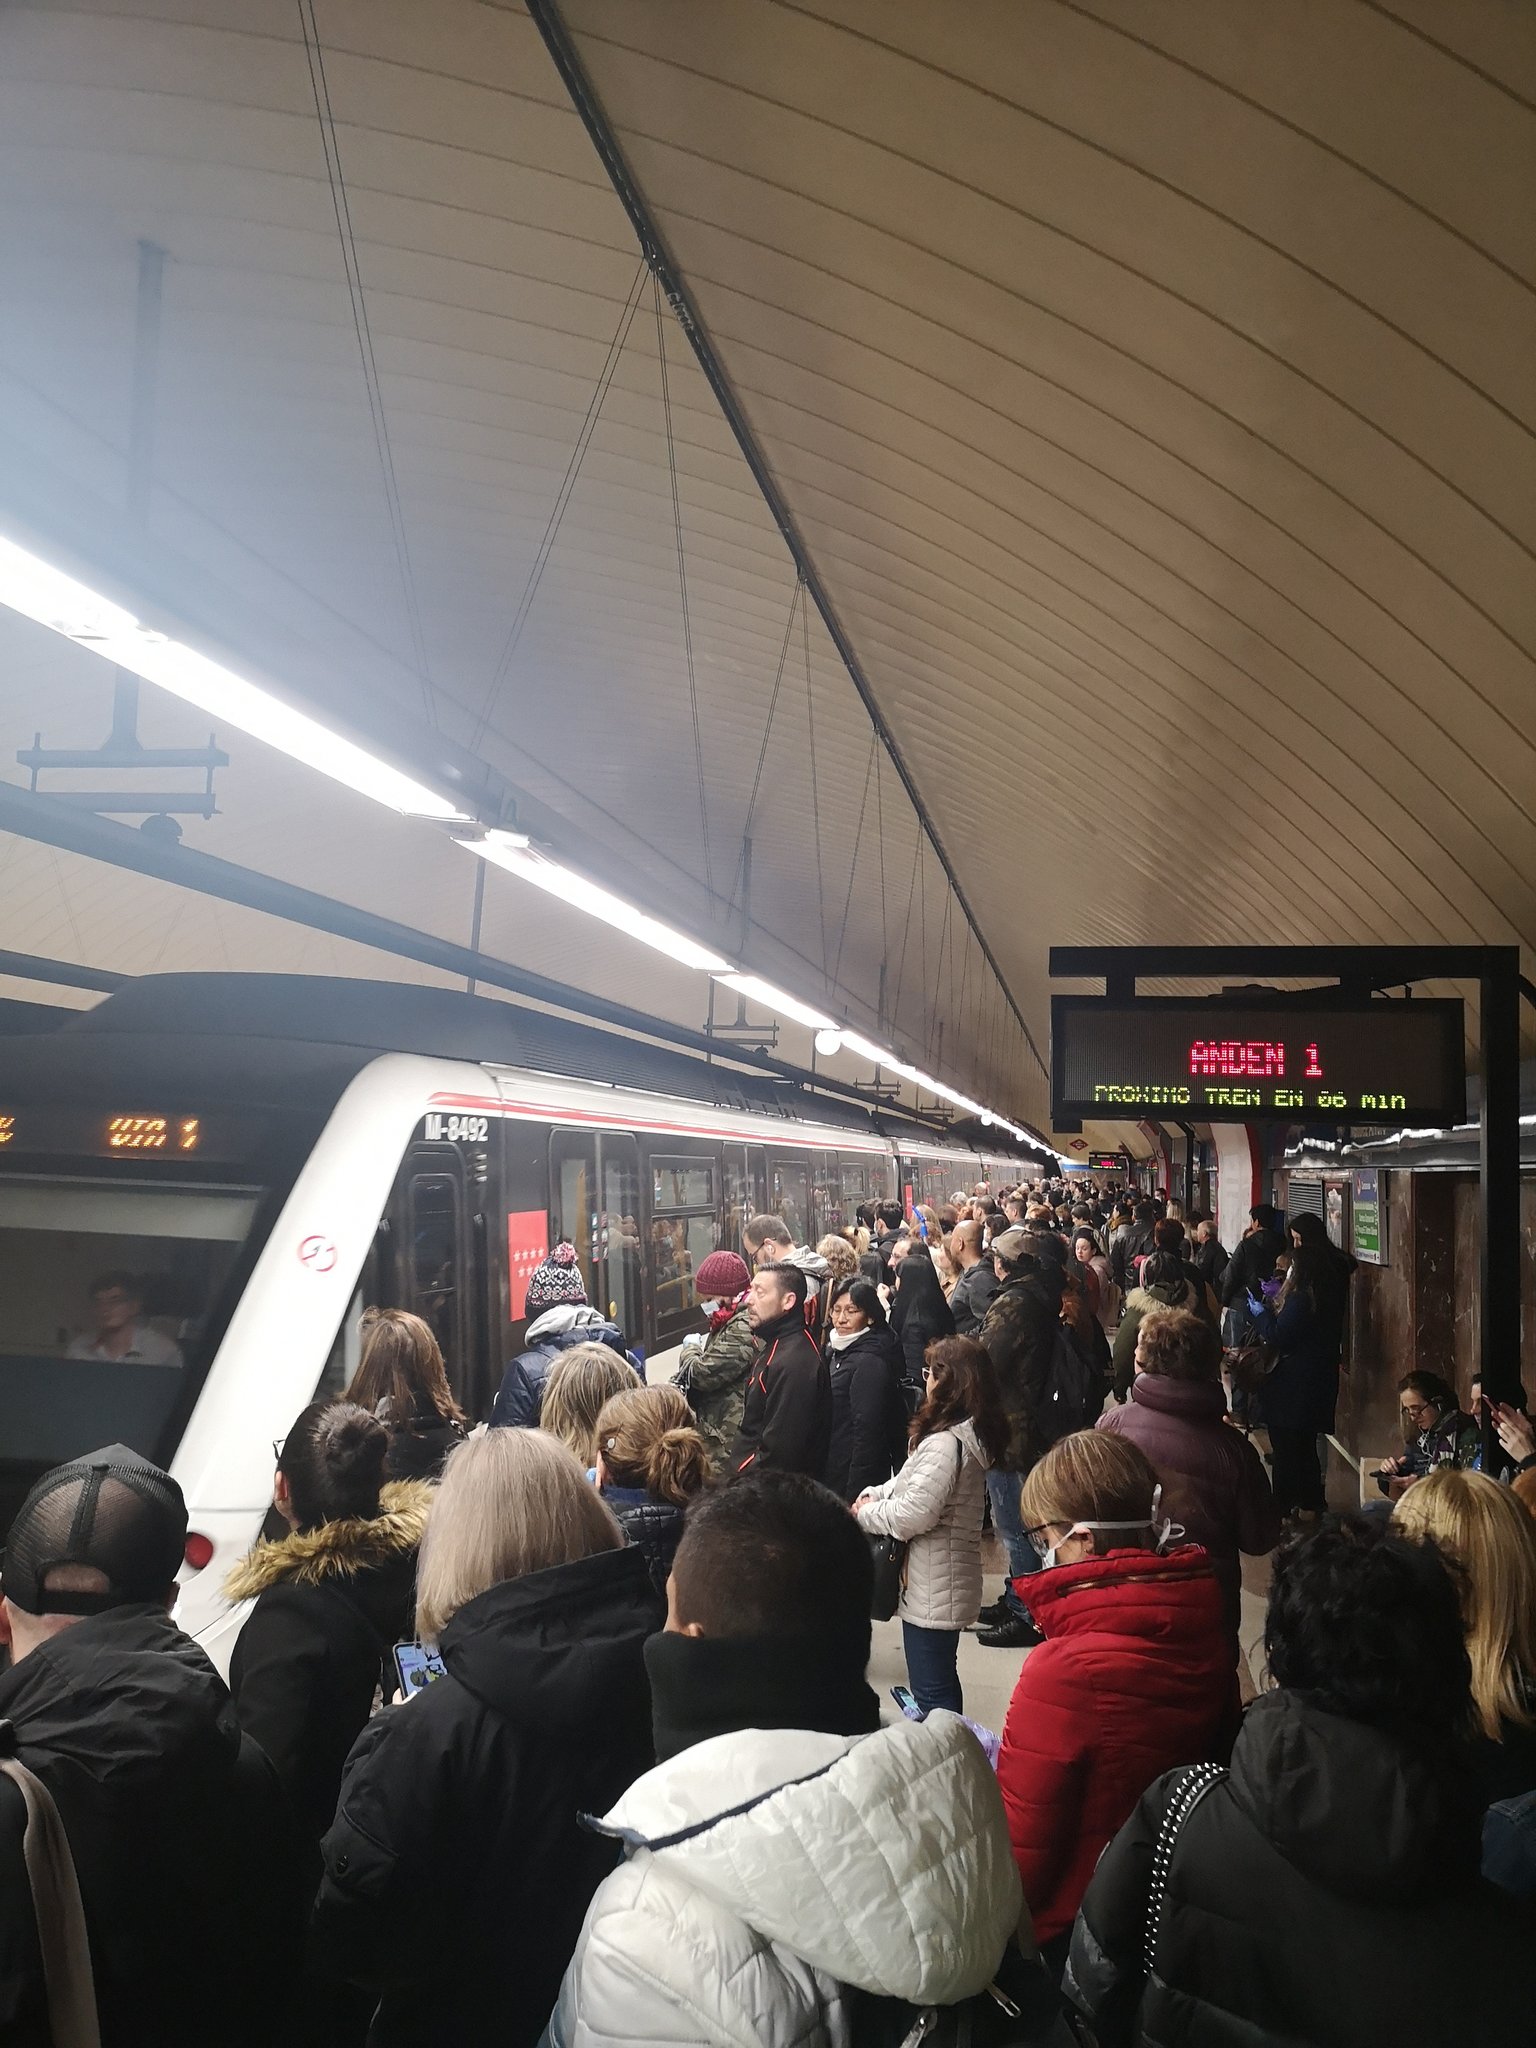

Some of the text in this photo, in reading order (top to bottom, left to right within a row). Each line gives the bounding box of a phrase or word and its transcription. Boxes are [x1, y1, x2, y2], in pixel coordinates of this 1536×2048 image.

[1190, 1041, 1322, 1076] ANDEN 1
[1094, 1085, 1191, 1104] PROXIMO
[1204, 1087, 1261, 1106] TREN
[1274, 1089, 1304, 1107] EN
[1317, 1090, 1347, 1108] 06
[424, 1113, 489, 1142] M-8492
